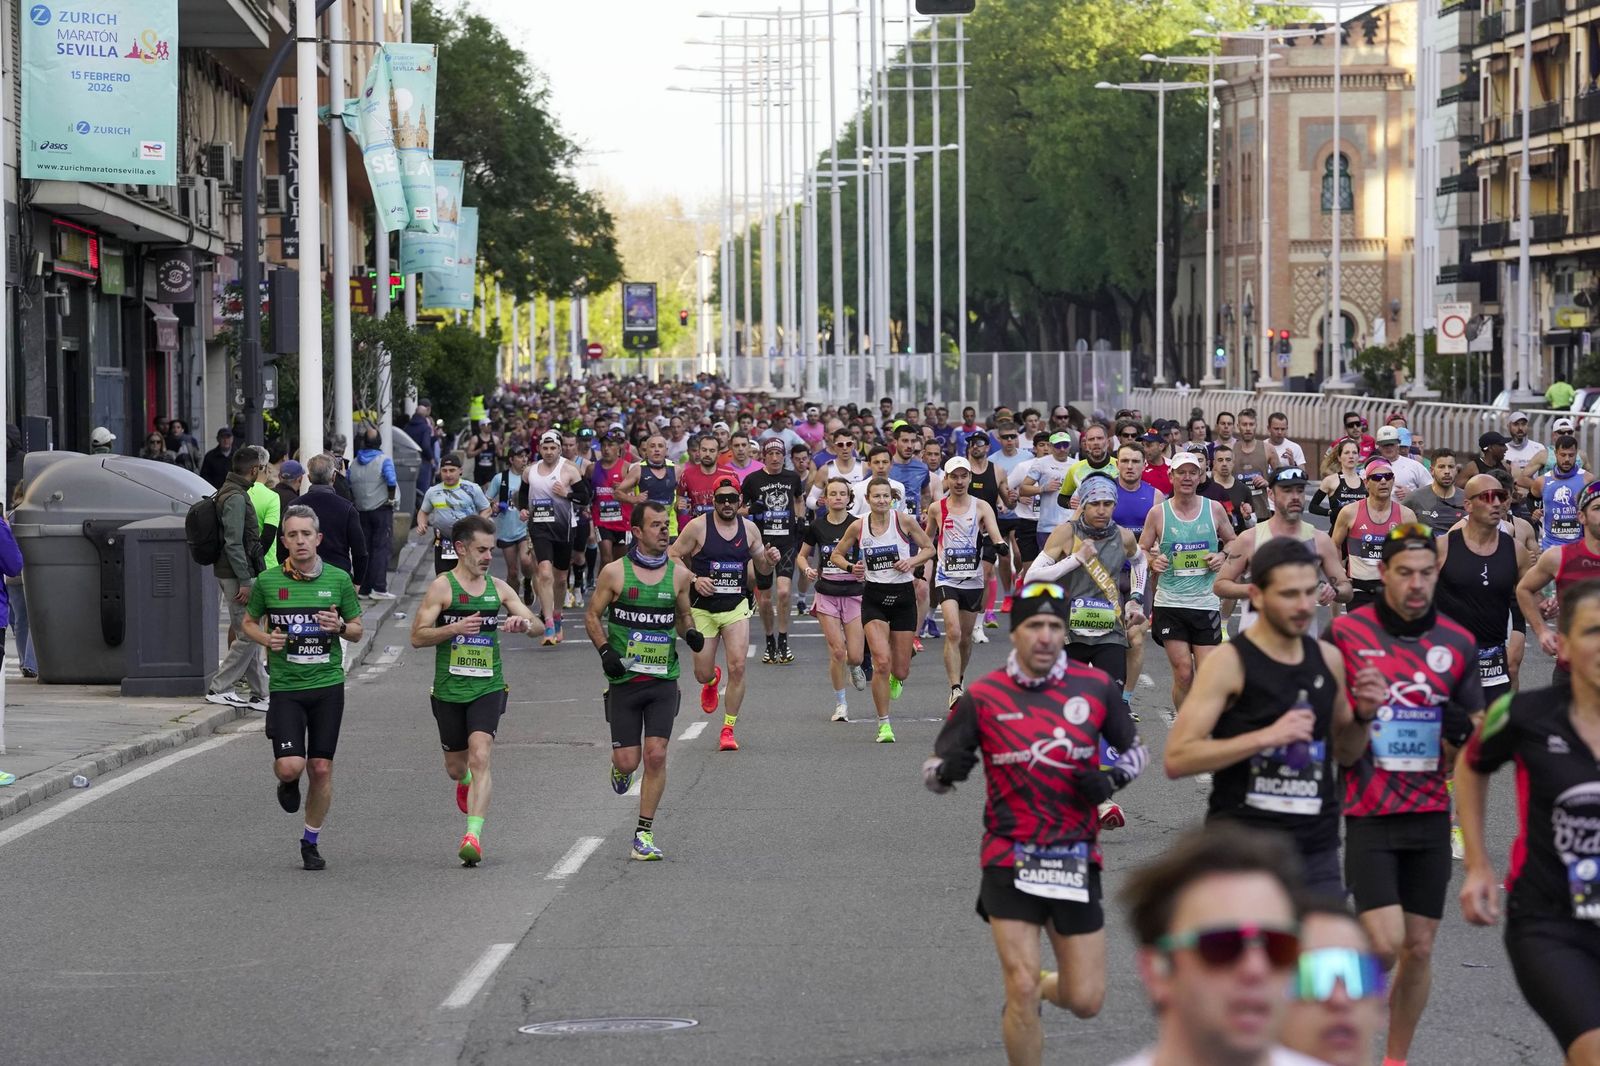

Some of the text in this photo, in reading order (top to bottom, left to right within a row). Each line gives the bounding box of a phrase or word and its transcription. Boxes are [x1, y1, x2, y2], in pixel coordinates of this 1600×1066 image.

[59, 11, 117, 25] ZURICH
[57, 29, 118, 43] MARATÓN
[57, 43, 118, 58] SEVILLA
[71, 70, 130, 82] 15 FEBRERO
[87, 83, 113, 92] 2026
[94, 126, 131, 135] ZURICH
[49, 142, 68, 150] asics
[37, 163, 156, 176] www.zurichmaratonsevilla.es
[160, 260, 191, 272] TATTOO
[873, 561, 894, 570] MARIE
[947, 563, 975, 571] GARBONI
[1184, 560, 1200, 568] GAV
[713, 578, 738, 586] CARLOS
[1086, 600, 1110, 608] ZURICH
[1069, 619, 1114, 630] FRANCISCO
[467, 637, 490, 645] ZURICH
[298, 645, 323, 654] PAKIS
[457, 657, 487, 667] IBORRA
[1396, 709, 1436, 720] ZURICH
[1388, 742, 1426, 755] ISAAC
[1254, 776, 1319, 797] RICARDO
[1018, 868, 1085, 888] CADENAS
